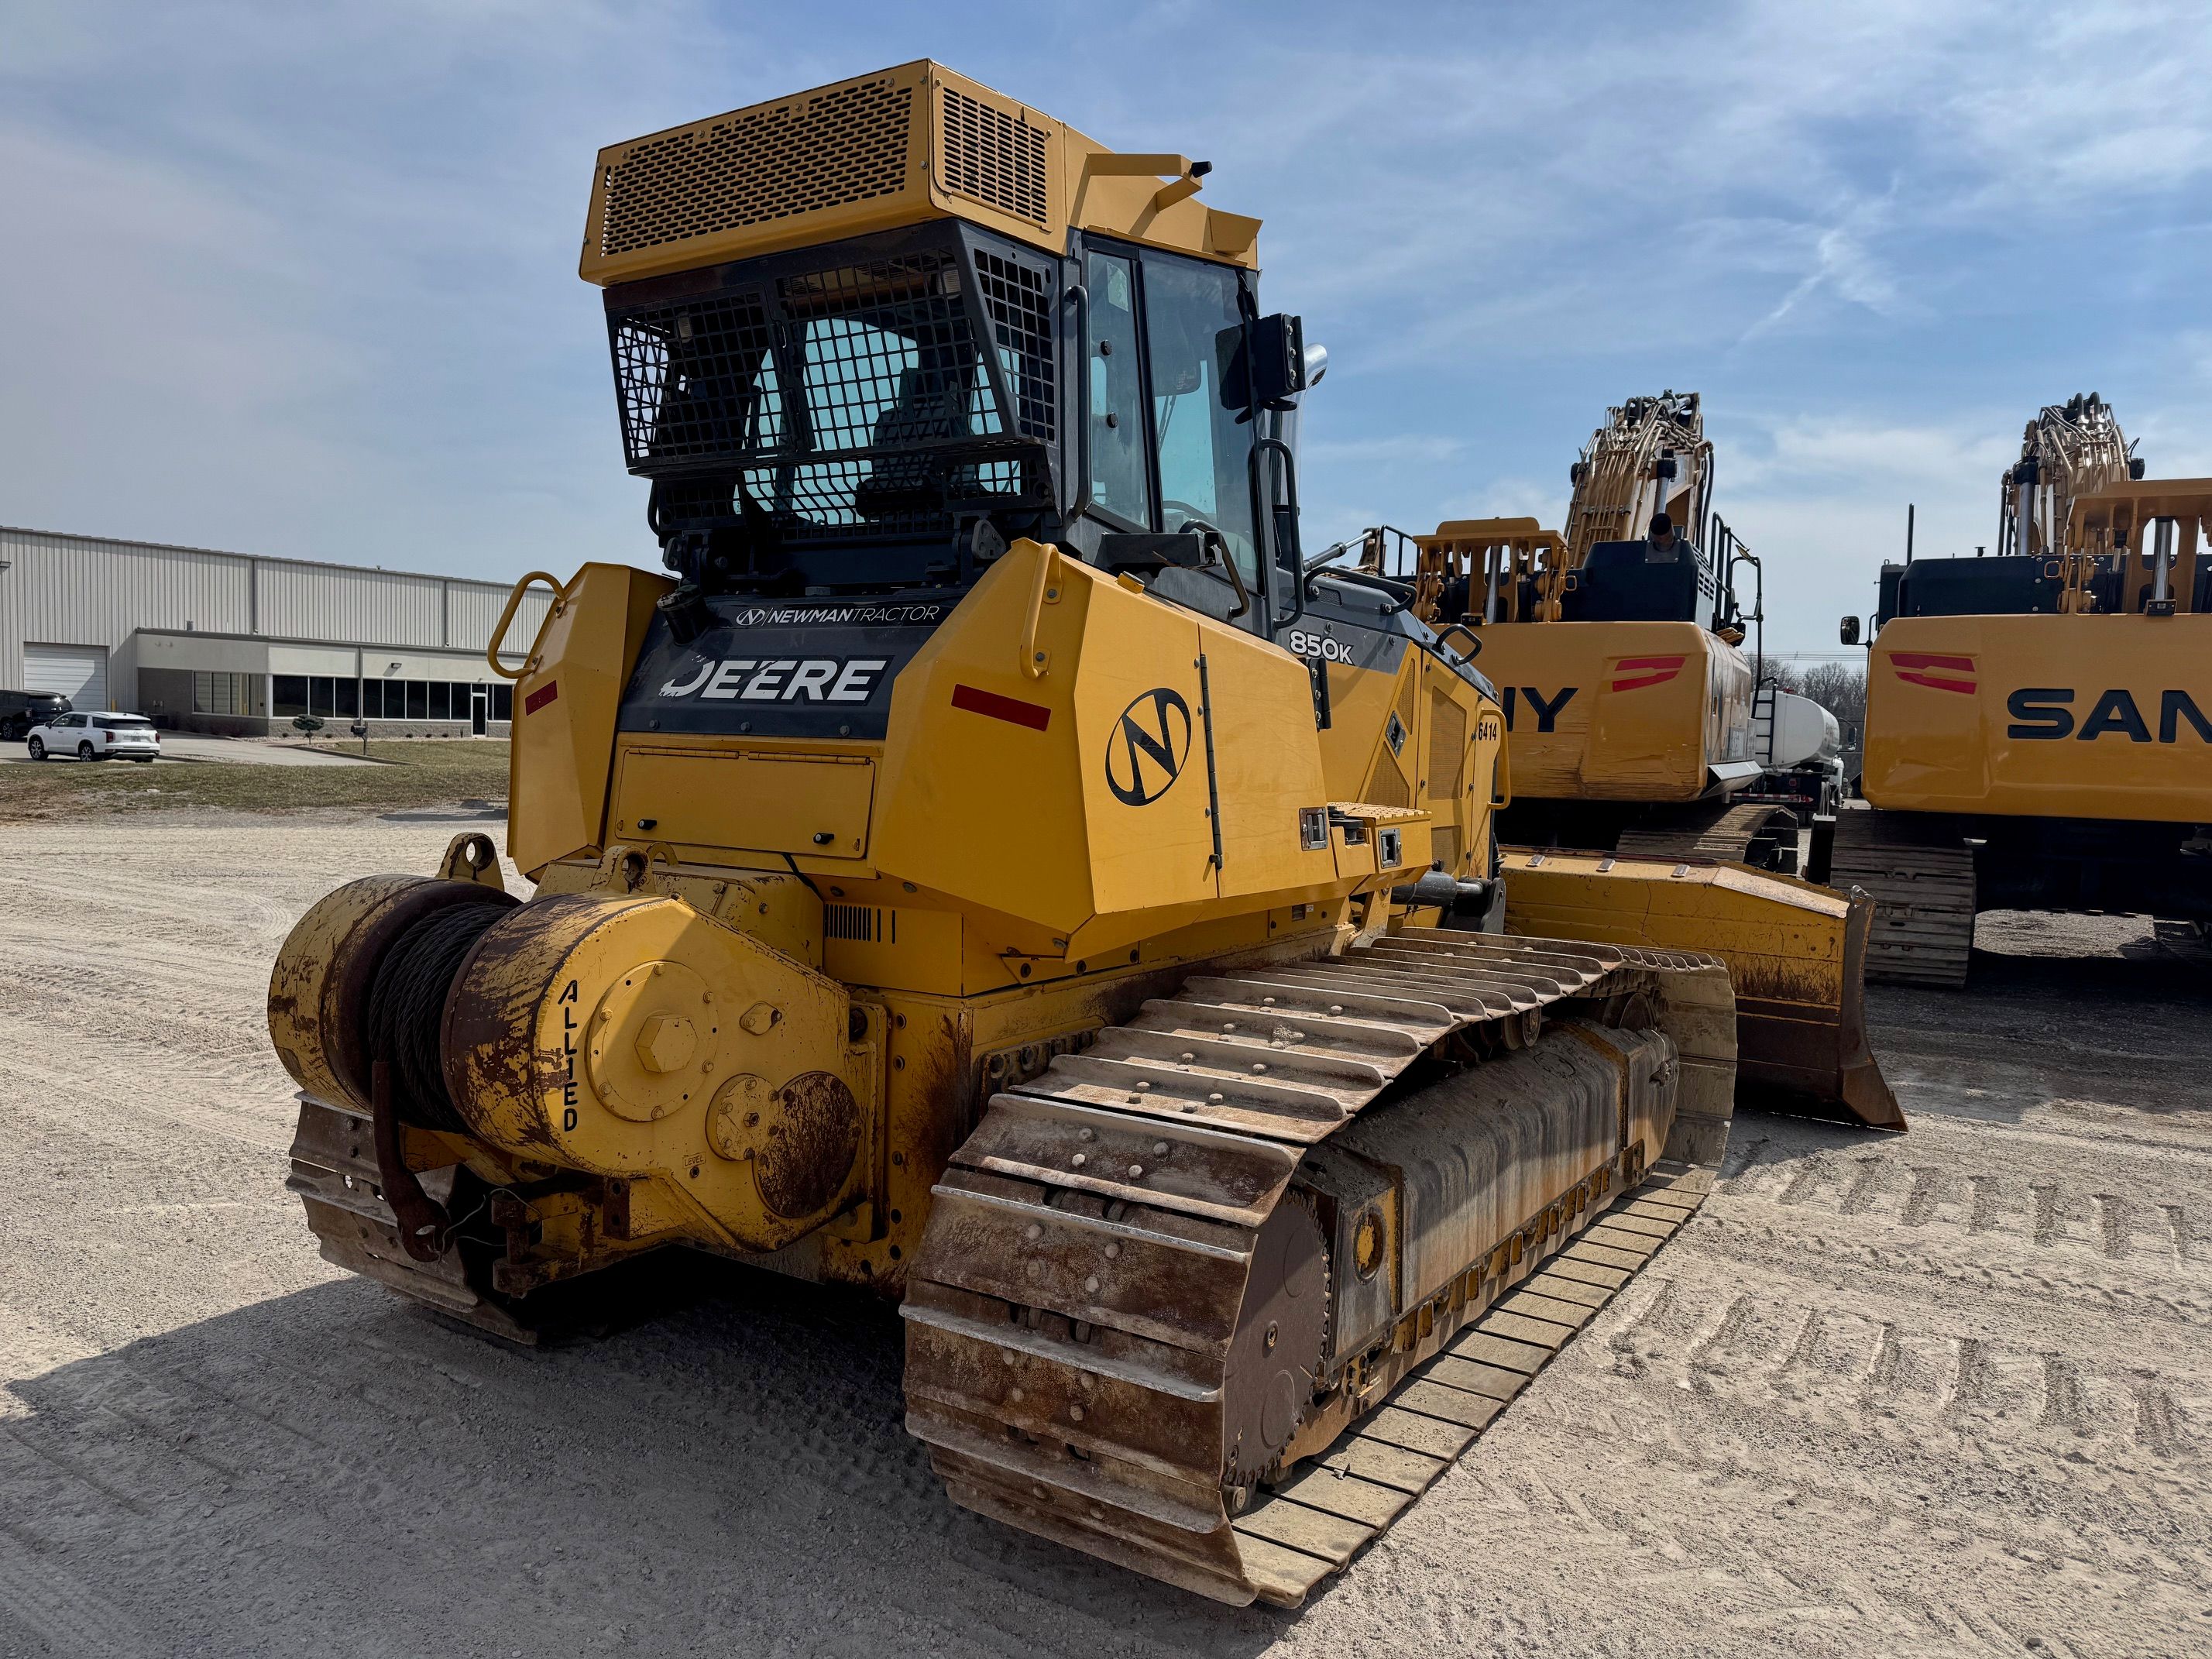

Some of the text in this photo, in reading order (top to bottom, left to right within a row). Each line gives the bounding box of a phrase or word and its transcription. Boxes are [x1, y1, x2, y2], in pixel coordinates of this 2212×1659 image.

[1290, 630, 1355, 665] 850K
[1478, 722, 1497, 741] 6414
[558, 980, 578, 1132] ALLIED
[684, 1154, 704, 1167] LEVEL
